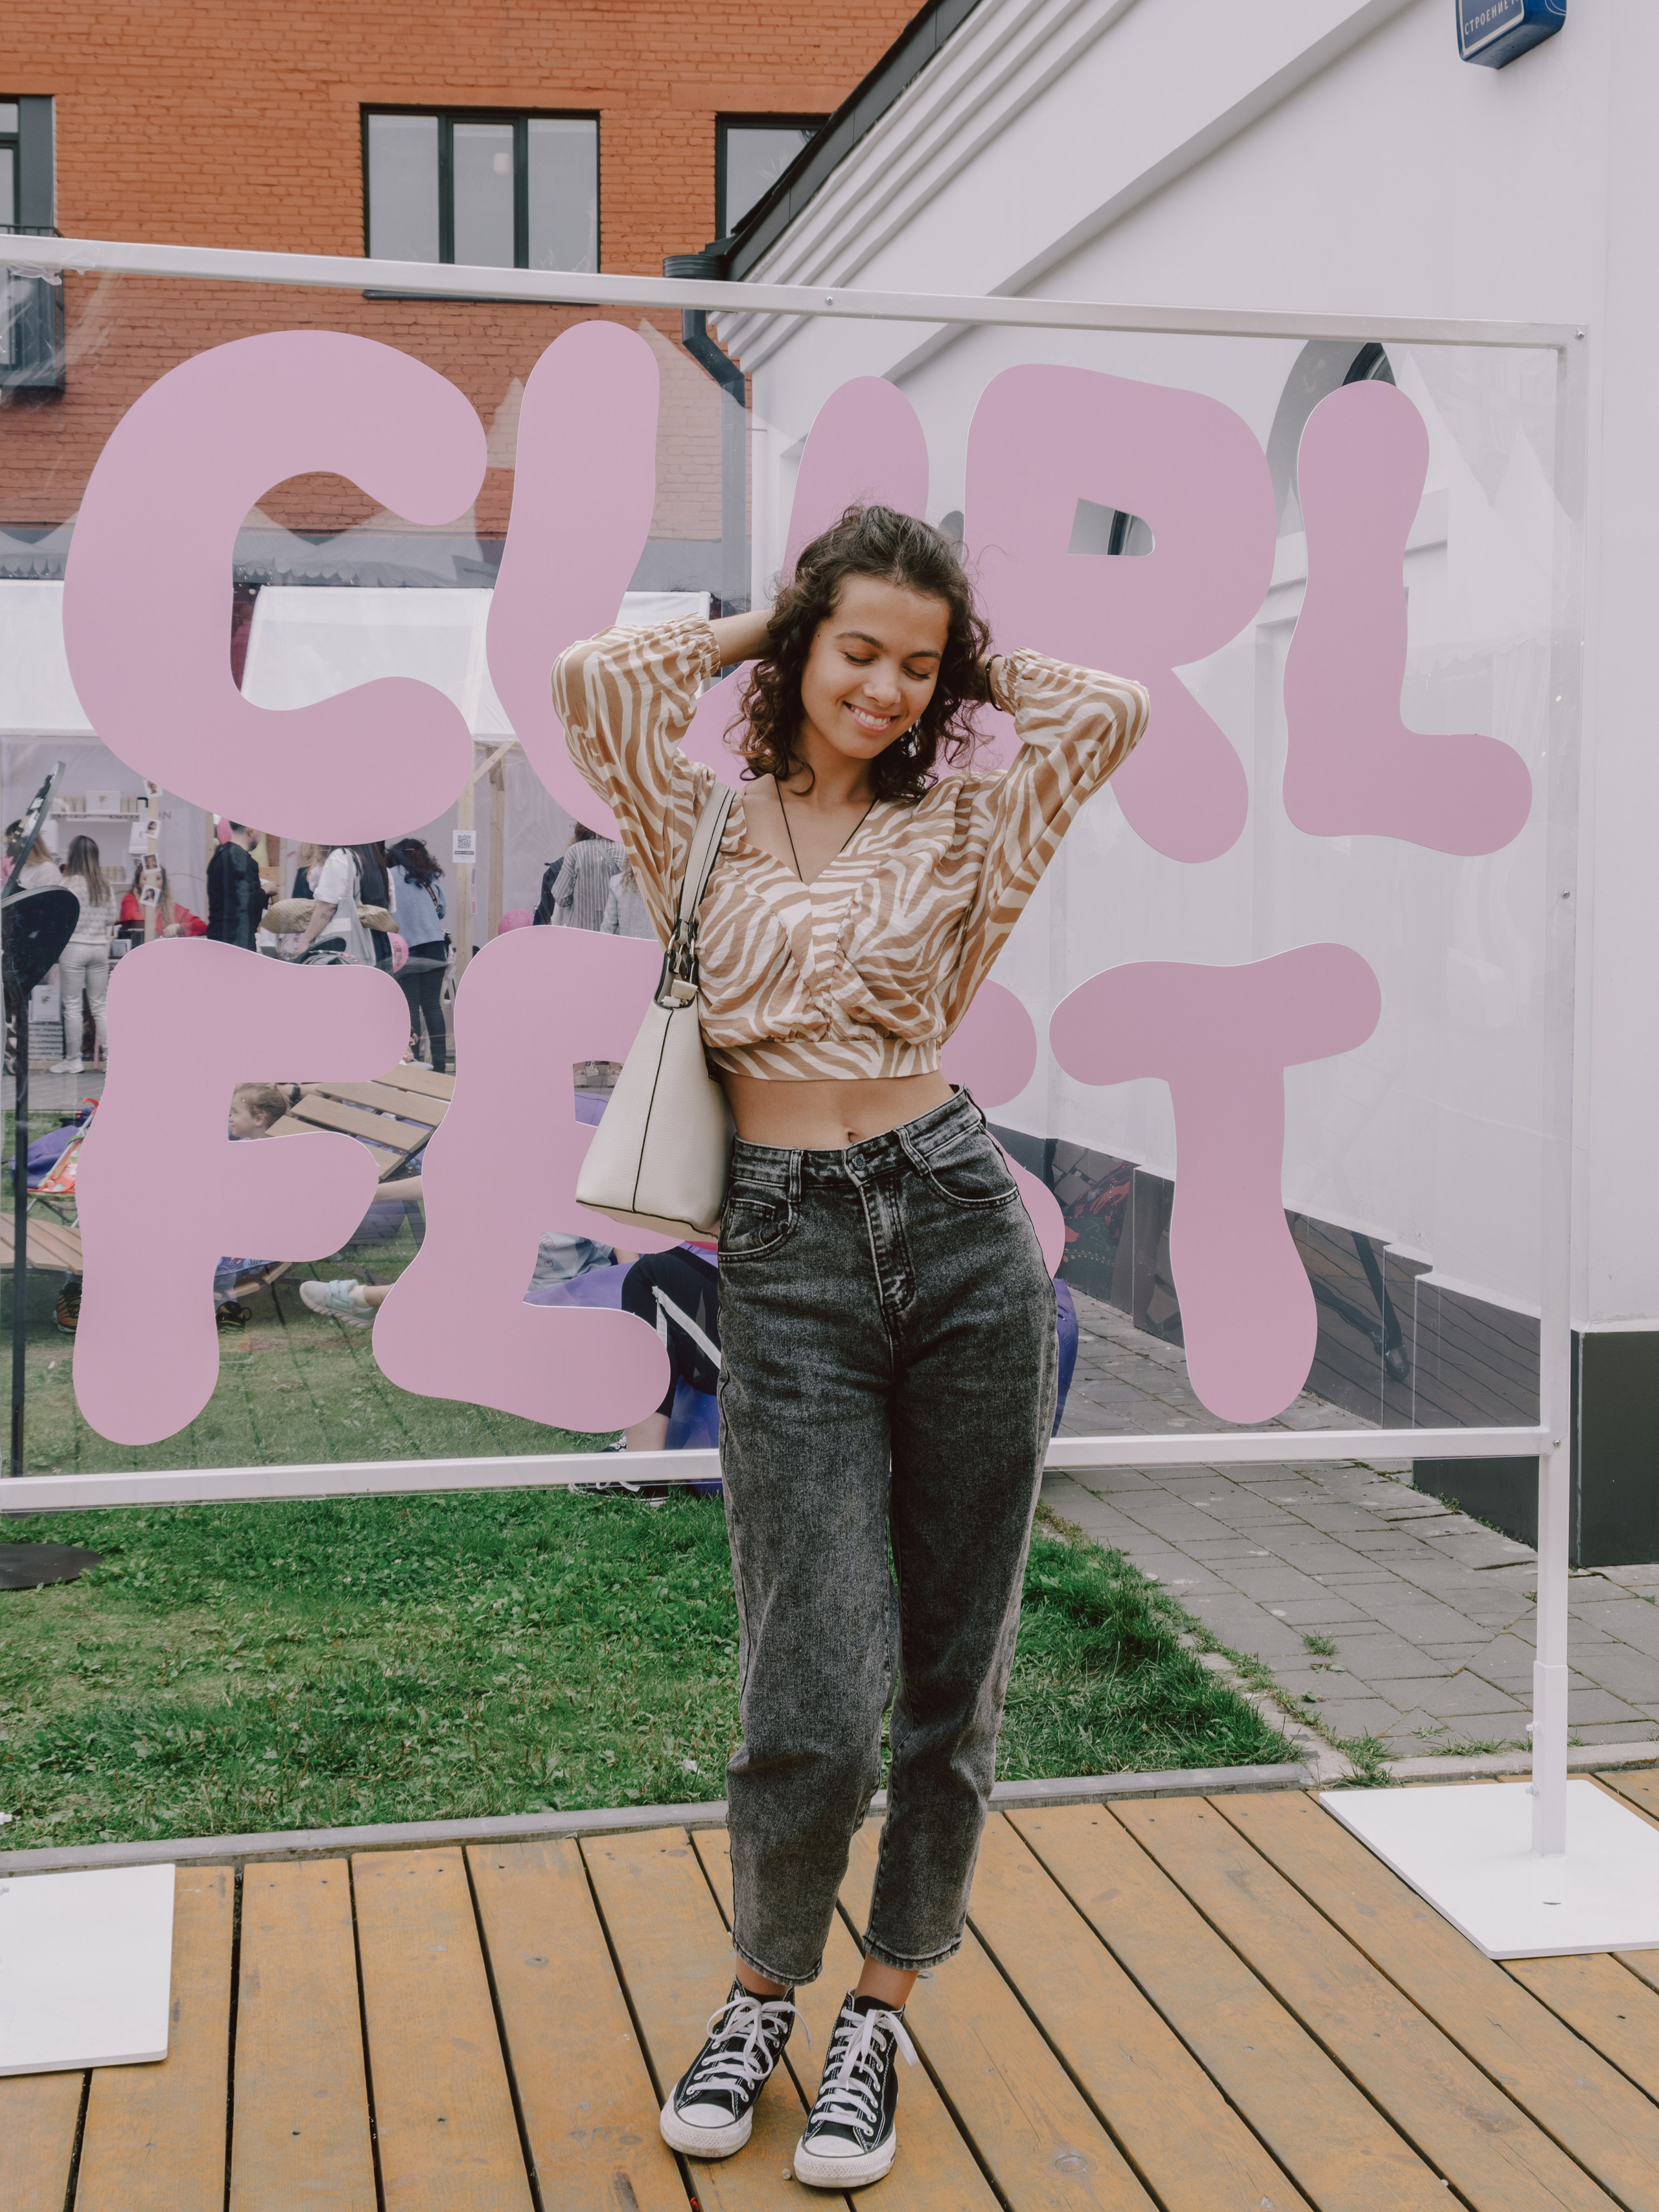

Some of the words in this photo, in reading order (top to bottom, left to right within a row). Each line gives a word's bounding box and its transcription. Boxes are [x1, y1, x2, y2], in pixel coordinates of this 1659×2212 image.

[1465, 0, 1509, 36] СТРОЕНИЕ
[63, 320, 1532, 863] CURL
[73, 925, 1382, 1445] FET
